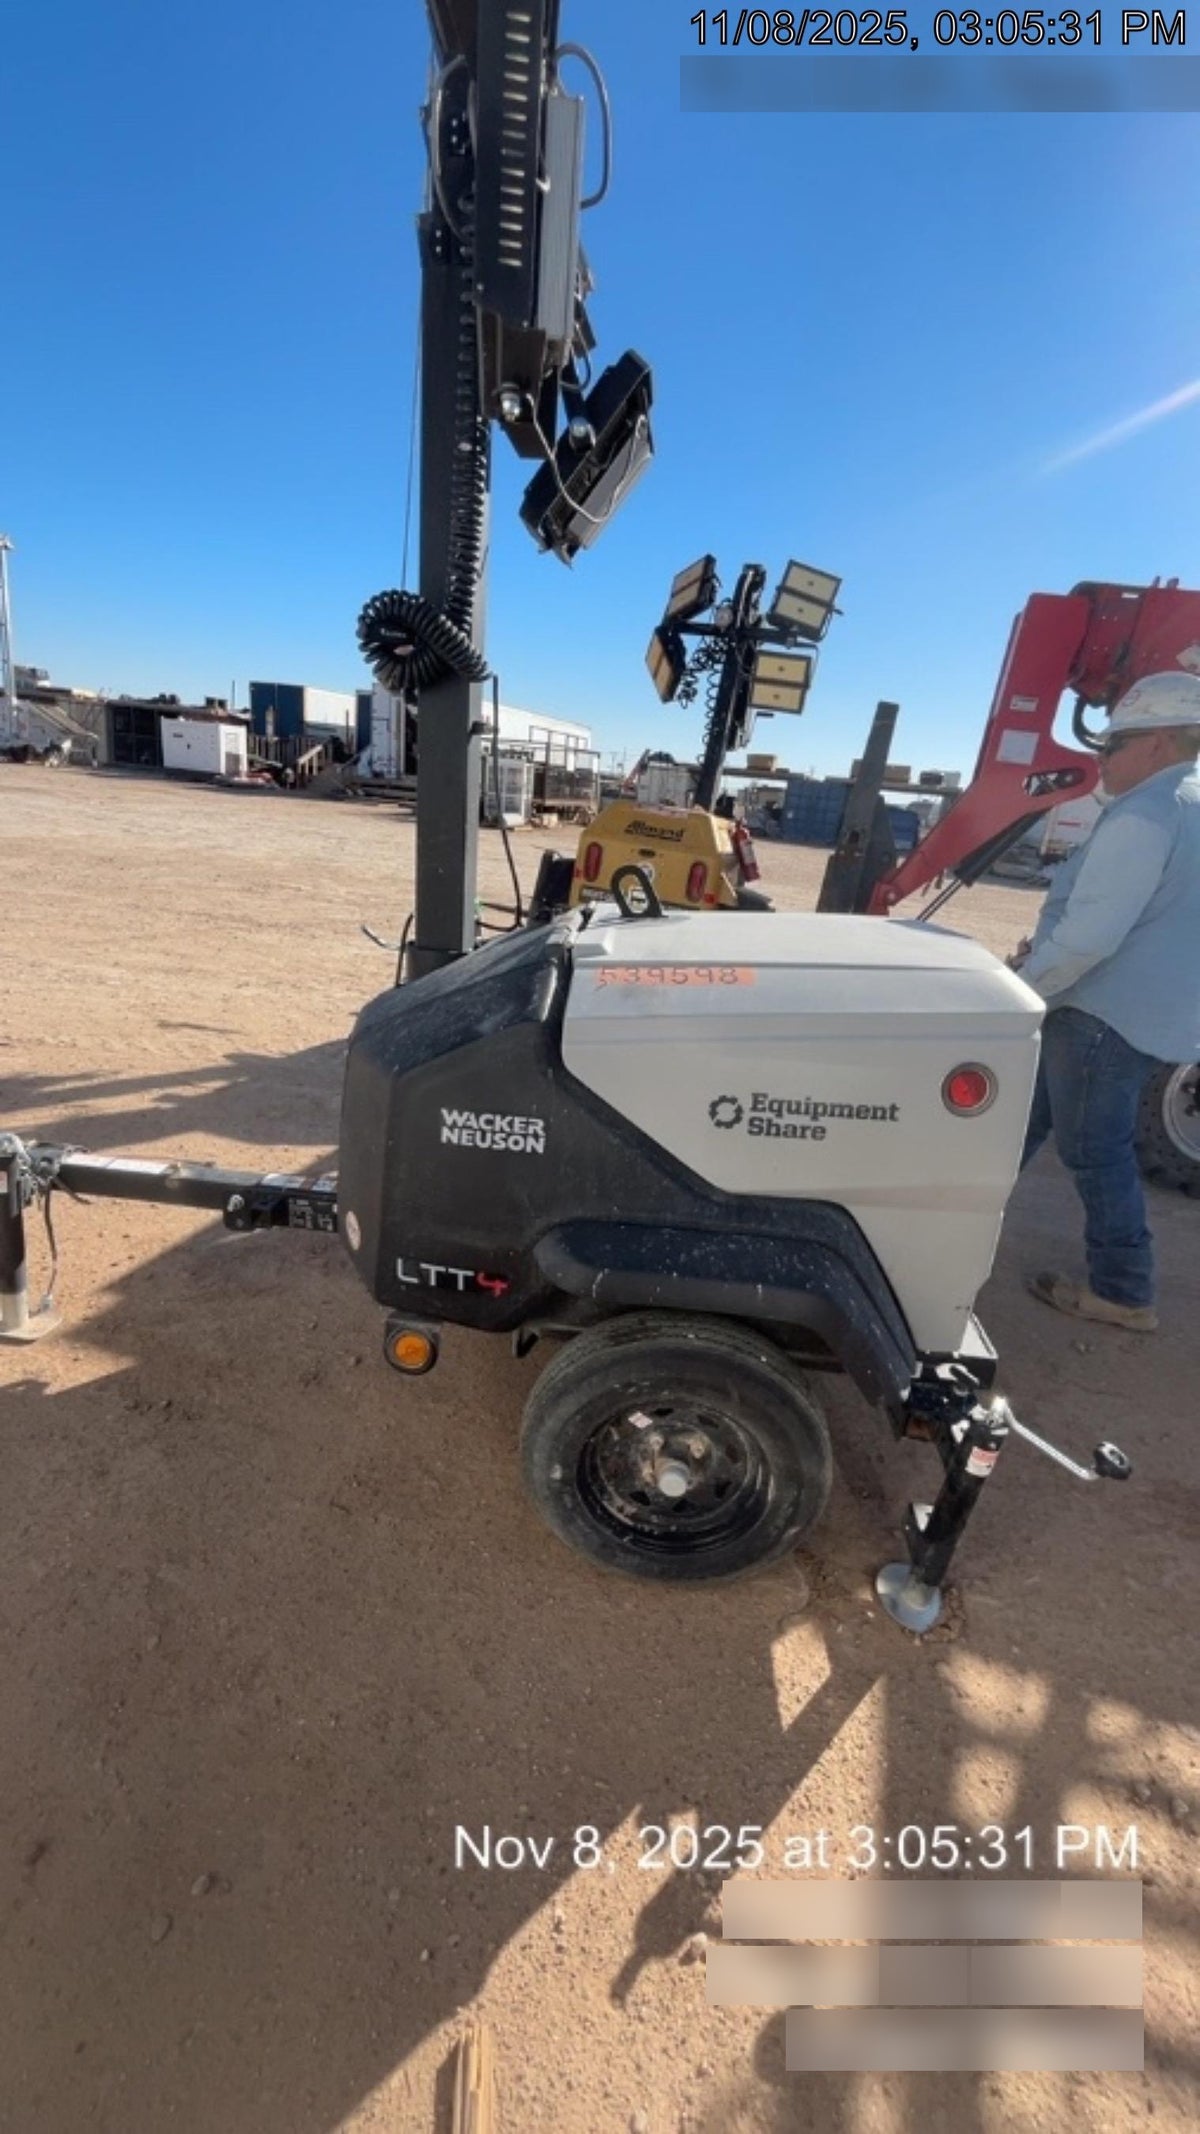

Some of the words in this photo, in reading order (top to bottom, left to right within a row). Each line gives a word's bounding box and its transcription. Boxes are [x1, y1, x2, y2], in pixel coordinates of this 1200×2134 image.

[441, 1107, 546, 1137] WACKER
[751, 1092, 900, 1122] Equipment
[441, 1126, 545, 1154] NEUSON
[747, 1116, 827, 1141] Share
[396, 1258, 508, 1297] LTT4
